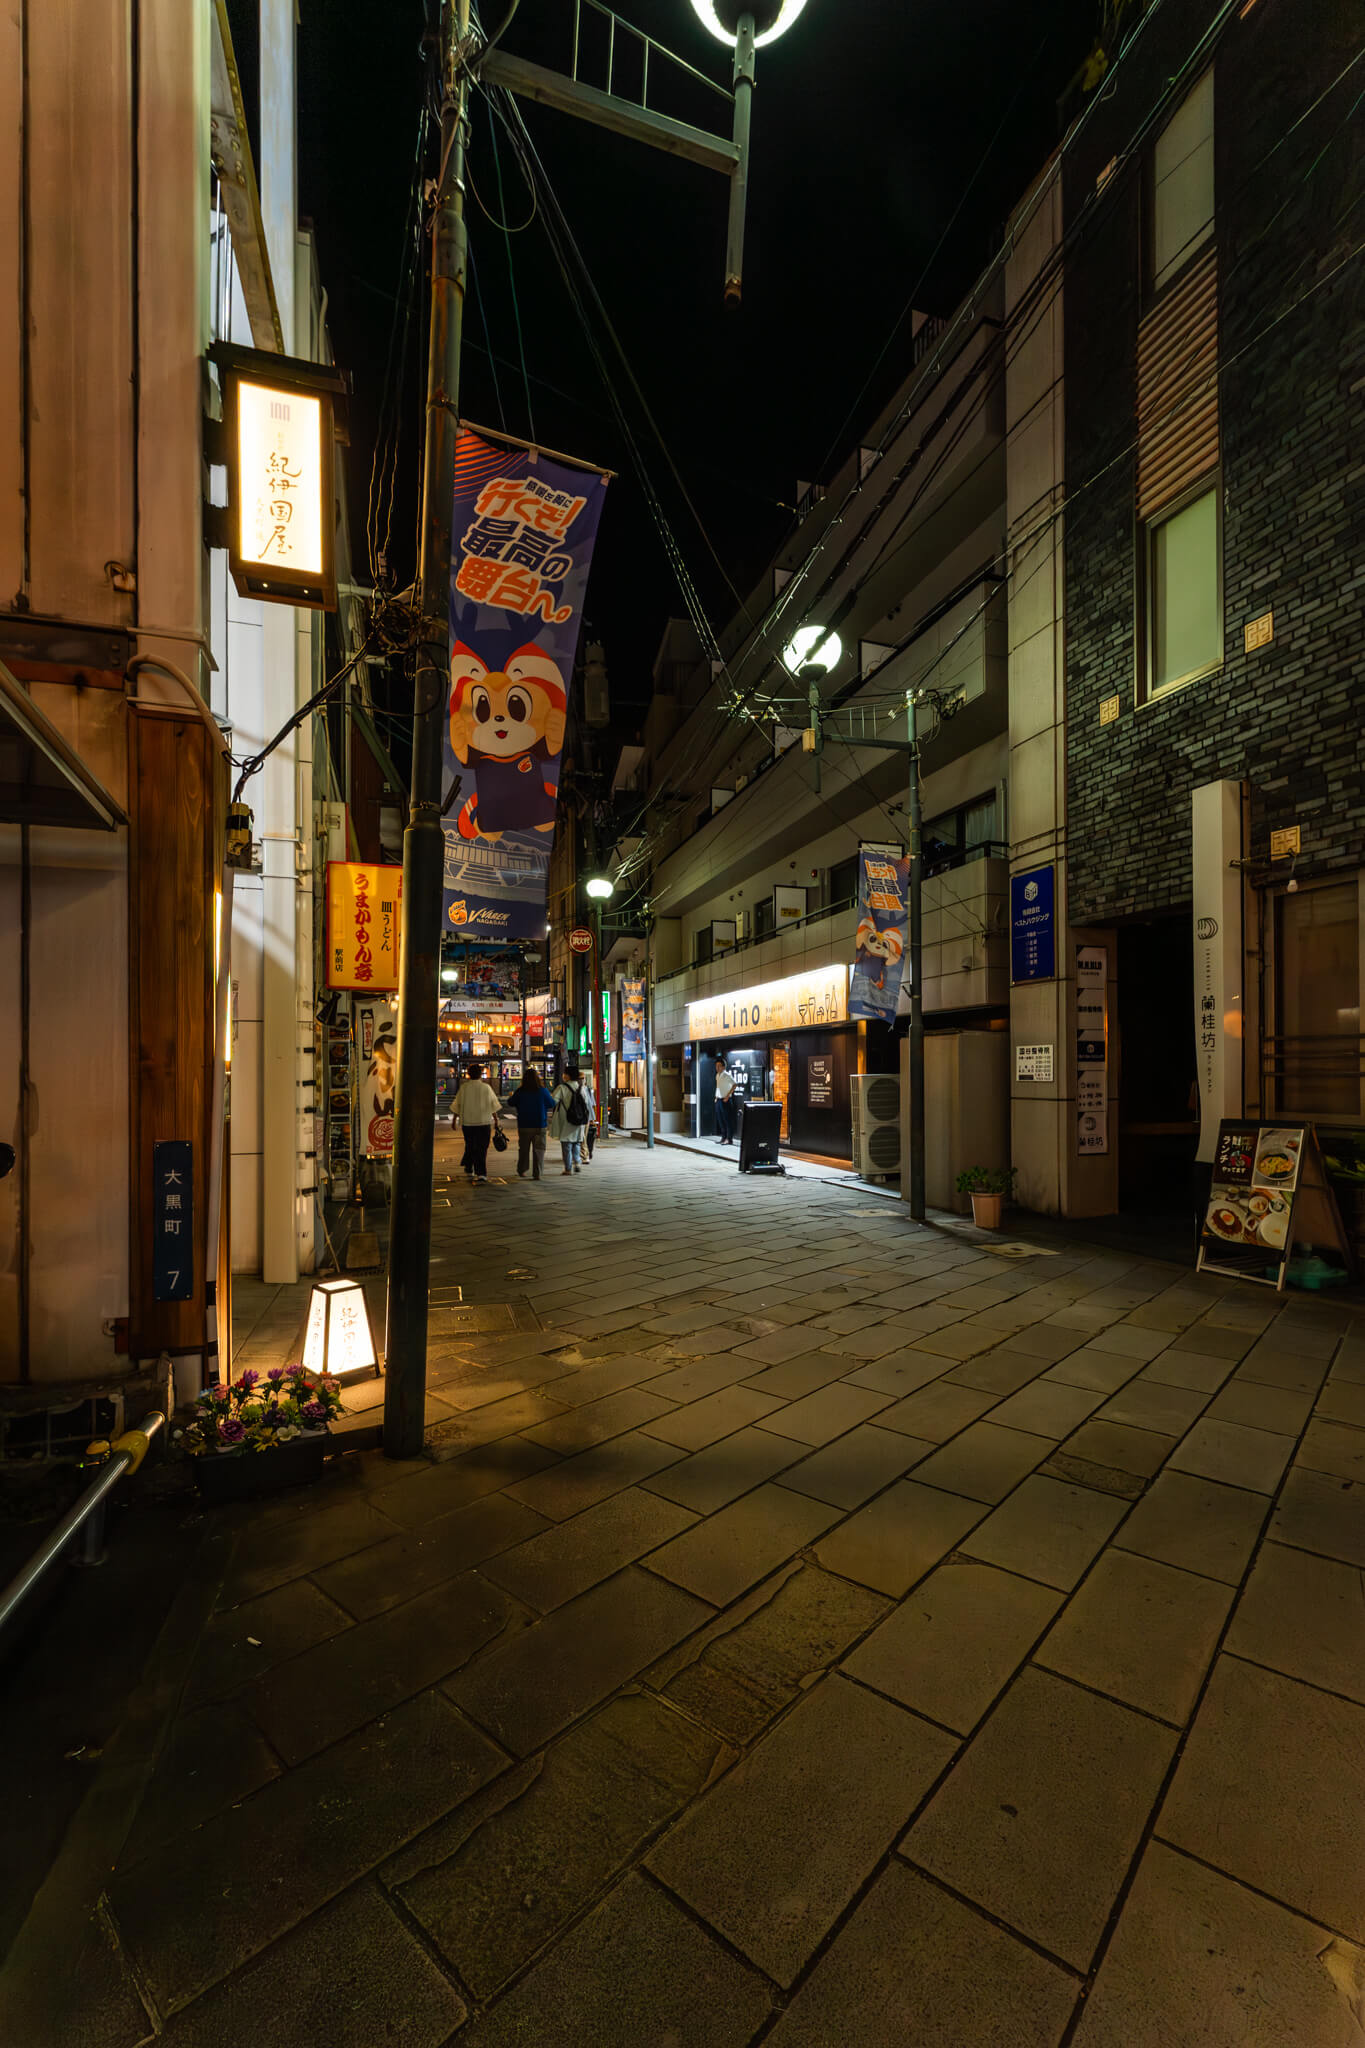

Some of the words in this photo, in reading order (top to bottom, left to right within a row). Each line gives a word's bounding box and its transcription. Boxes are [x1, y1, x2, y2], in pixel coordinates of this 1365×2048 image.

[463, 517, 569, 580] 最高の
[381, 901, 392, 951] 皿うどん
[722, 1002, 760, 1029] Lino
[1201, 995, 1215, 1049] 蘭桂坊
[1219, 1135, 1231, 1164] ランチ
[164, 1169, 183, 1235] 大黒町
[167, 1271, 180, 1290] 7
